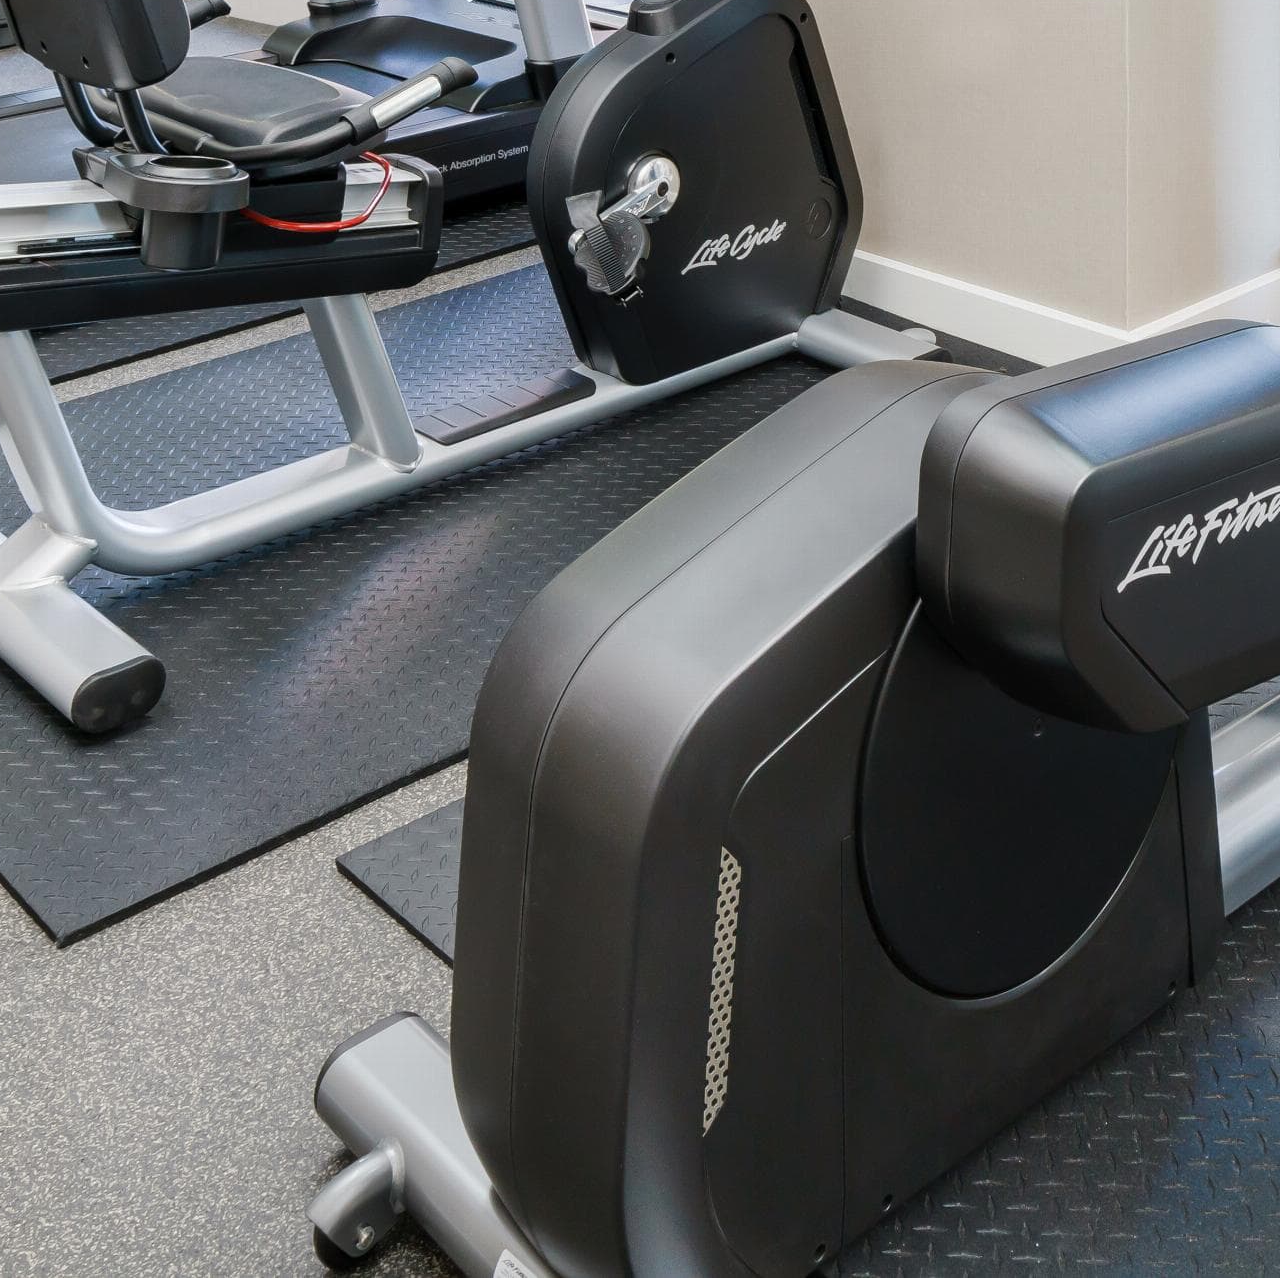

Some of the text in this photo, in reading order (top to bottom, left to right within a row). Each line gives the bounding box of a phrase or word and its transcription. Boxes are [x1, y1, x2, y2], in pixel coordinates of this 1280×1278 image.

[449, 153, 496, 171] Absorption
[497, 145, 529, 160] System
[681, 219, 787, 275] Life Cycle
[1117, 514, 1198, 593] Life
